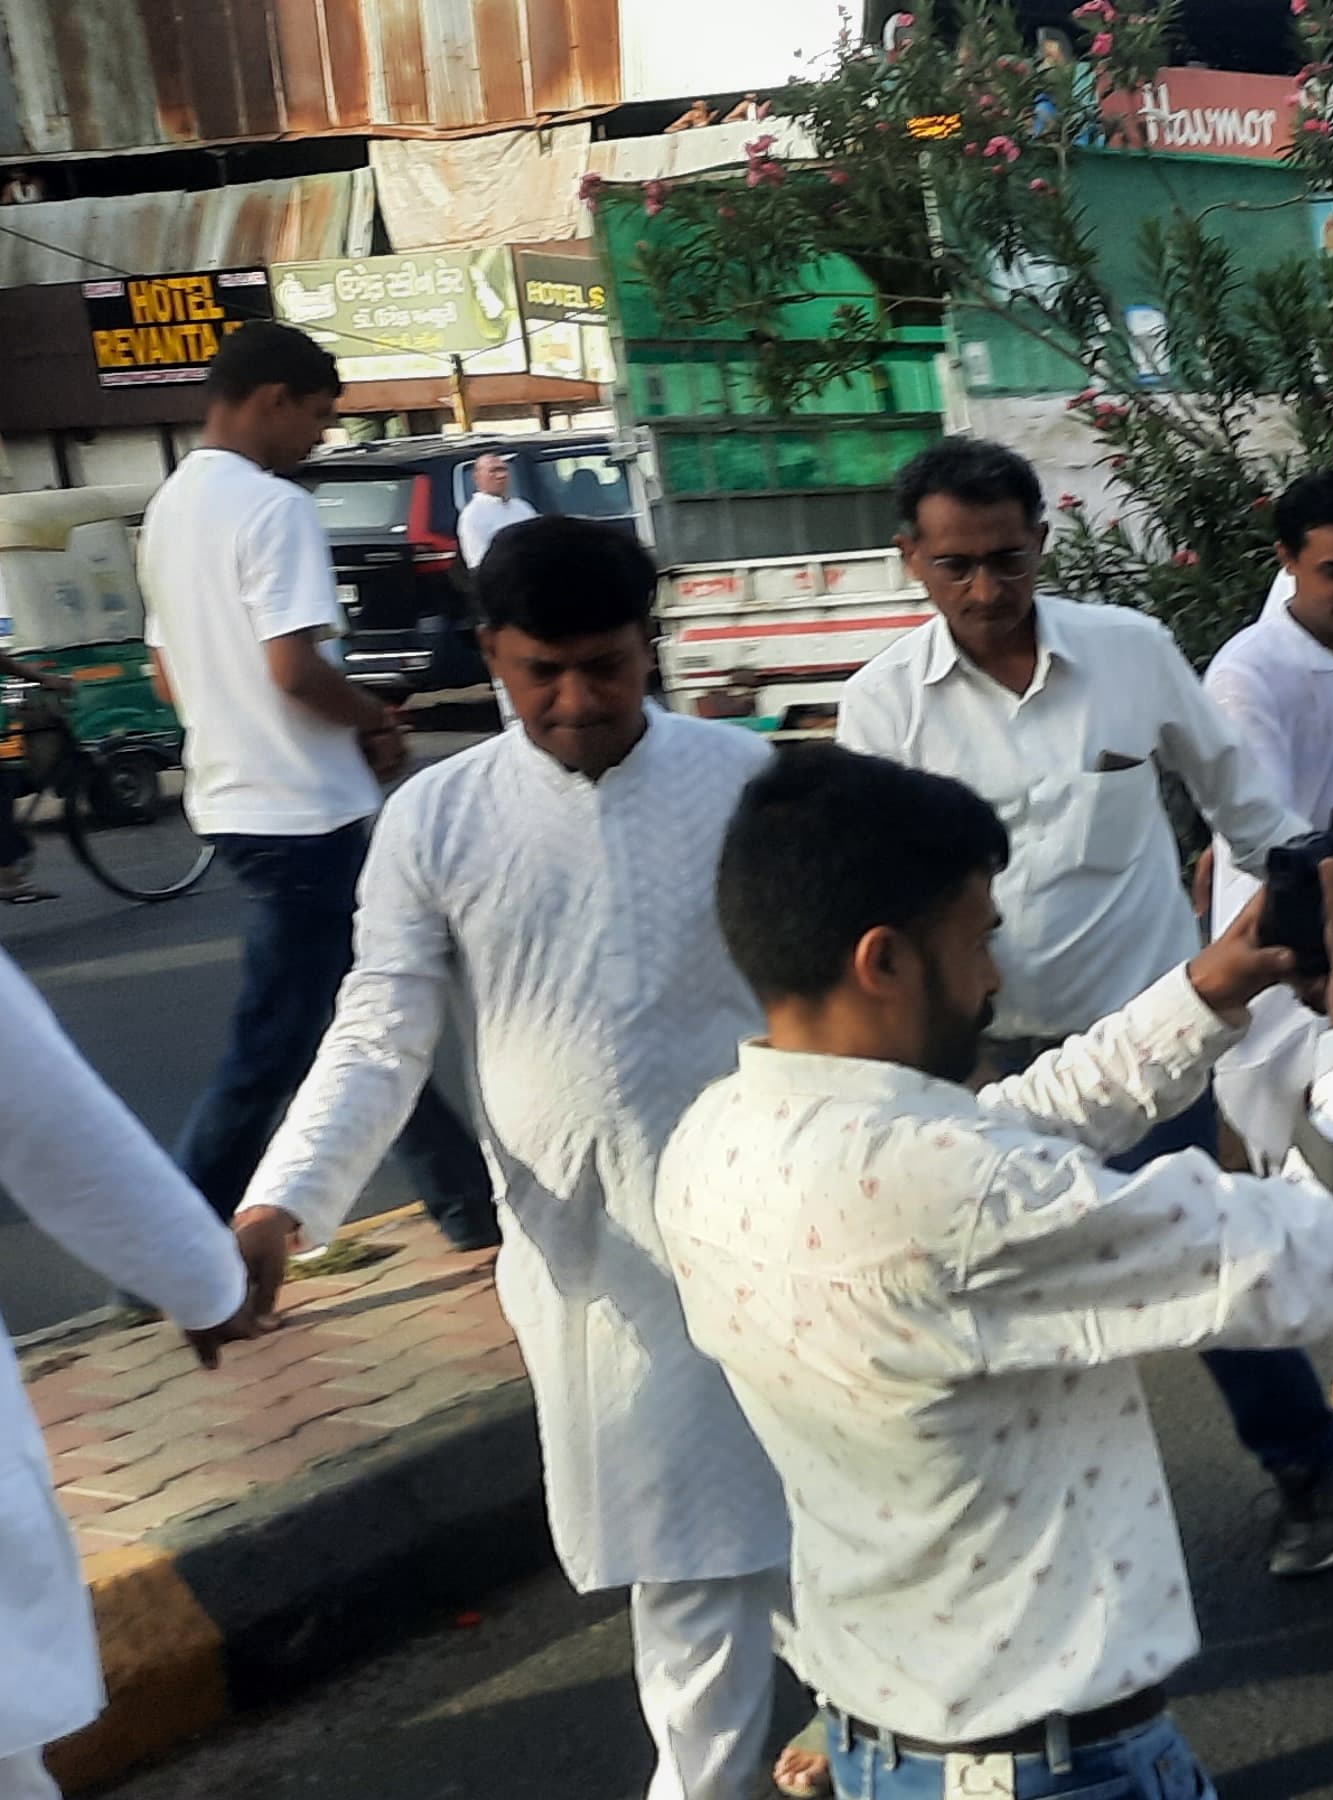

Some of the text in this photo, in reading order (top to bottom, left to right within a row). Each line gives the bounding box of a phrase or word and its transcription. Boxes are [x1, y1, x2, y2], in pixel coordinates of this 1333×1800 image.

[127, 276, 225, 324] HOTEL
[525, 281, 589, 309] HOTEL
[92, 323, 220, 368] REVANTA
